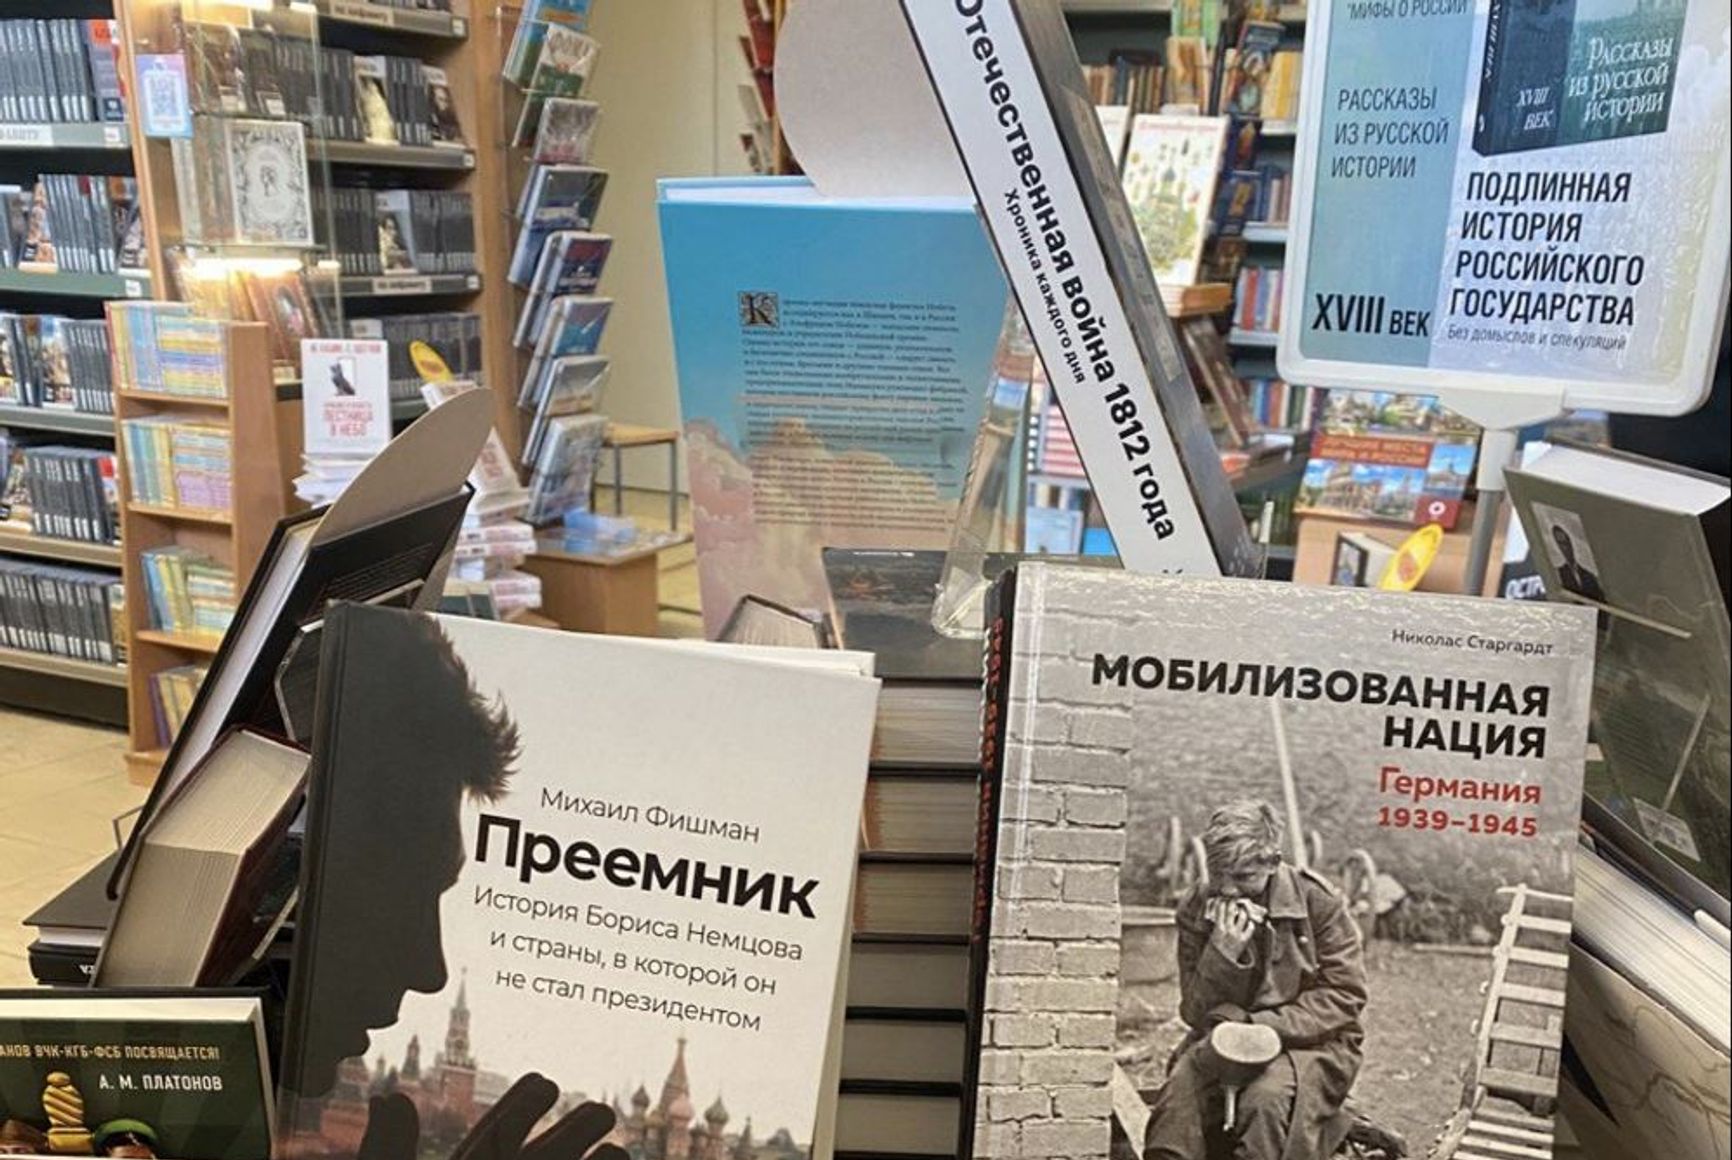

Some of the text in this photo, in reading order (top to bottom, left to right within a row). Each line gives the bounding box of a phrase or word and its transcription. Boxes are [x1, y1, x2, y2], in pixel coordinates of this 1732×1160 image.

[1337, 87, 1438, 111] РАССКАЗЫ
[1584, 92, 1666, 123] ИСТОРИИ
[1334, 117, 1449, 145] ИЗ РУССКОЙ
[1331, 156, 1416, 179] ИСТОРИИ
[1466, 171, 1633, 204] ПОДЛИННАЯ
[1460, 211, 1583, 243] ИСТОРИЯ
[956, 0, 1075, 274] Отечественная
[1063, 276, 1116, 382] война
[1105, 382, 1151, 461] 1812
[1133, 463, 1175, 540] года
[1455, 246, 1645, 286] РОССИЙСКОГО
[1005, 188, 1086, 384] Хроника каждого дня
[1312, 293, 1432, 338] XVIII ВЕК
[1449, 288, 1634, 326] ГОСУДАРСТВА
[1448, 325, 1627, 352] Без домыслов и спекуляций
[1392, 629, 1554, 658] Николас Старгардт
[1091, 653, 1551, 720] МОБИЛИЗОВАННАЯ
[1383, 715, 1548, 760] НАЦИЯ
[1378, 766, 1543, 805] Германия
[540, 786, 760, 844] Михаил Фишман
[474, 813, 820, 920] Преемник
[473, 884, 803, 962] История Бориса Немцова
[490, 930, 777, 996] и страны, в которой он
[495, 970, 762, 1033] не стал президентом
[35, 1044, 122, 1059] ВЧК-КГБ-ФСБ
[125, 1045, 220, 1061] ПОСВЯЩАЕТСЯ!
[99, 1073, 223, 1091] А. М. ПЛАТОНОВ
